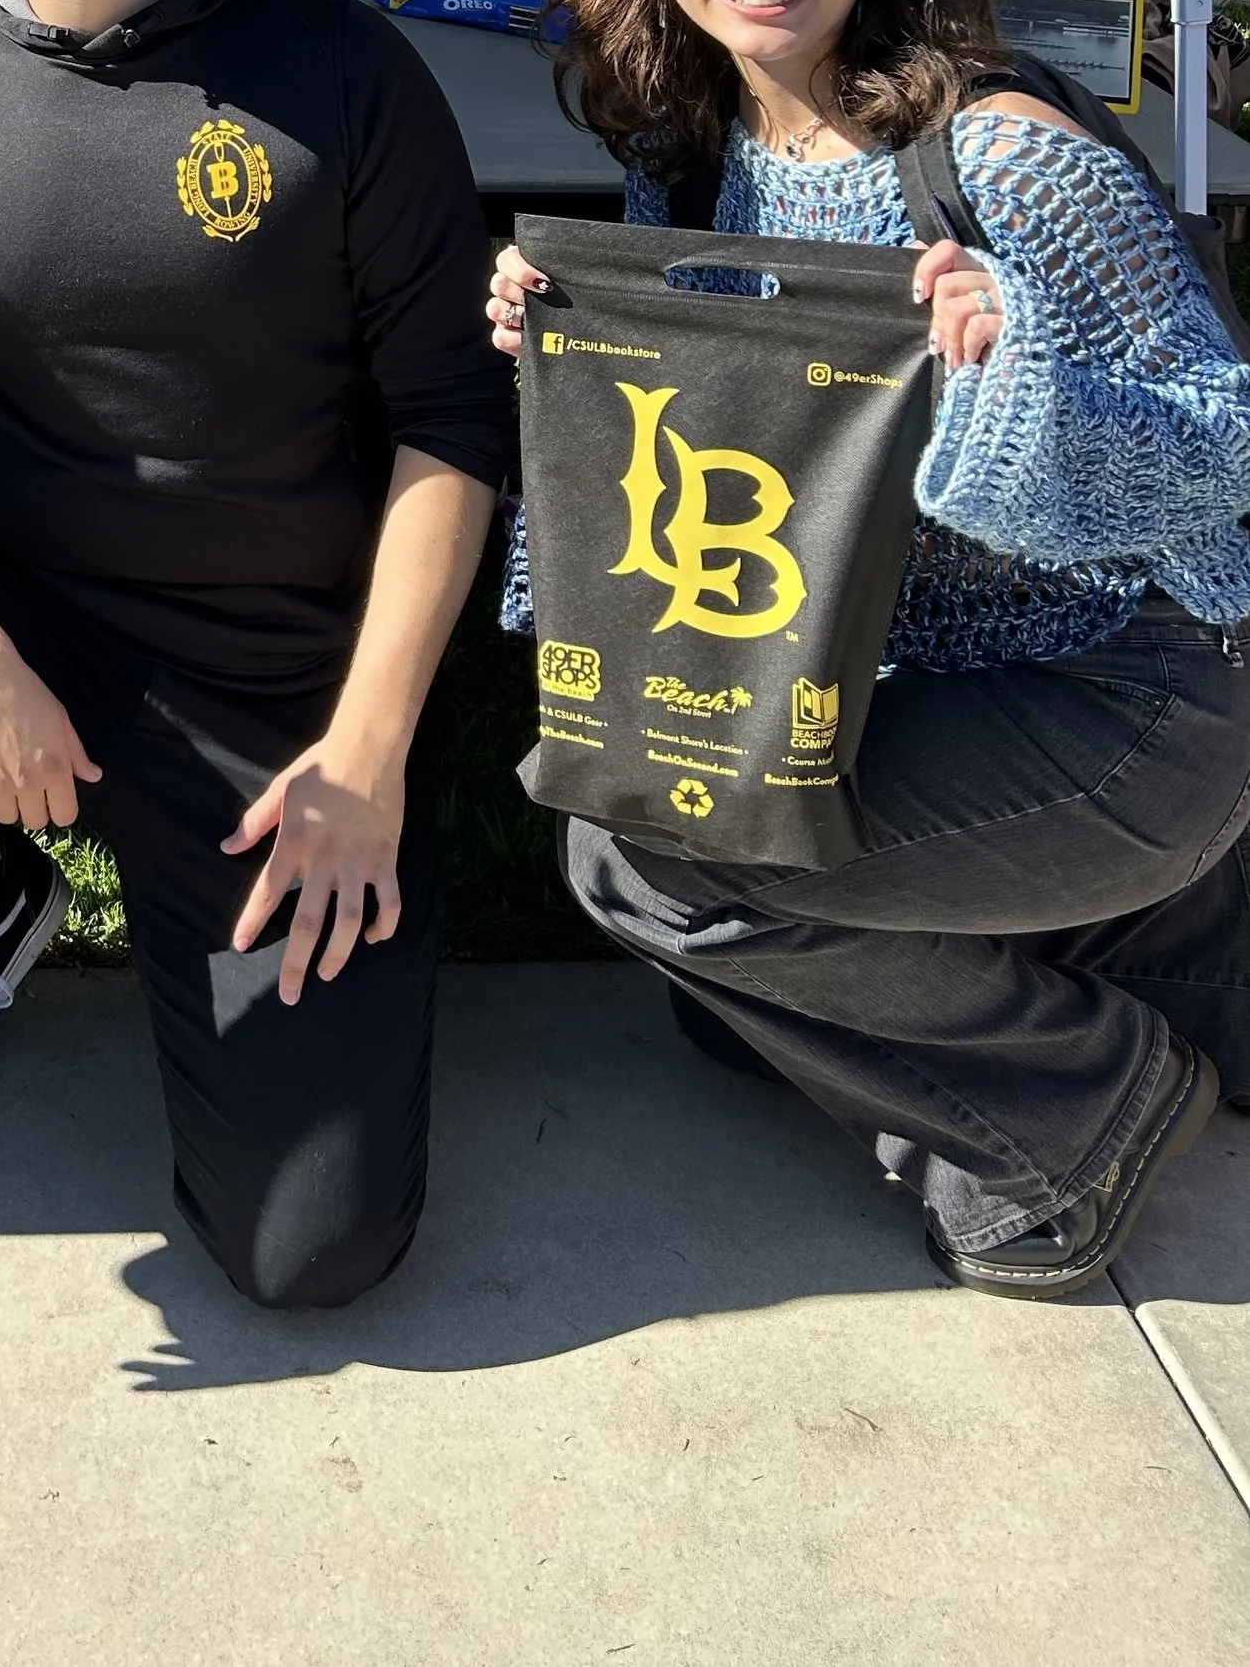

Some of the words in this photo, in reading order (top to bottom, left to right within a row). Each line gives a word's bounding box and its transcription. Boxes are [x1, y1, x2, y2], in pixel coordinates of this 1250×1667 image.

[201, 133, 232, 146] STATE
[242, 147, 260, 206] UNIVERSITY
[206, 160, 240, 200] B
[214, 211, 251, 229] ROWING
[833, 371, 903, 388] @49erShops
[607, 381, 807, 637] LB
[666, 676, 687, 690] The
[643, 676, 729, 712] Beach
[554, 709, 584, 723] CSULB
[709, 742, 743, 756] Location
